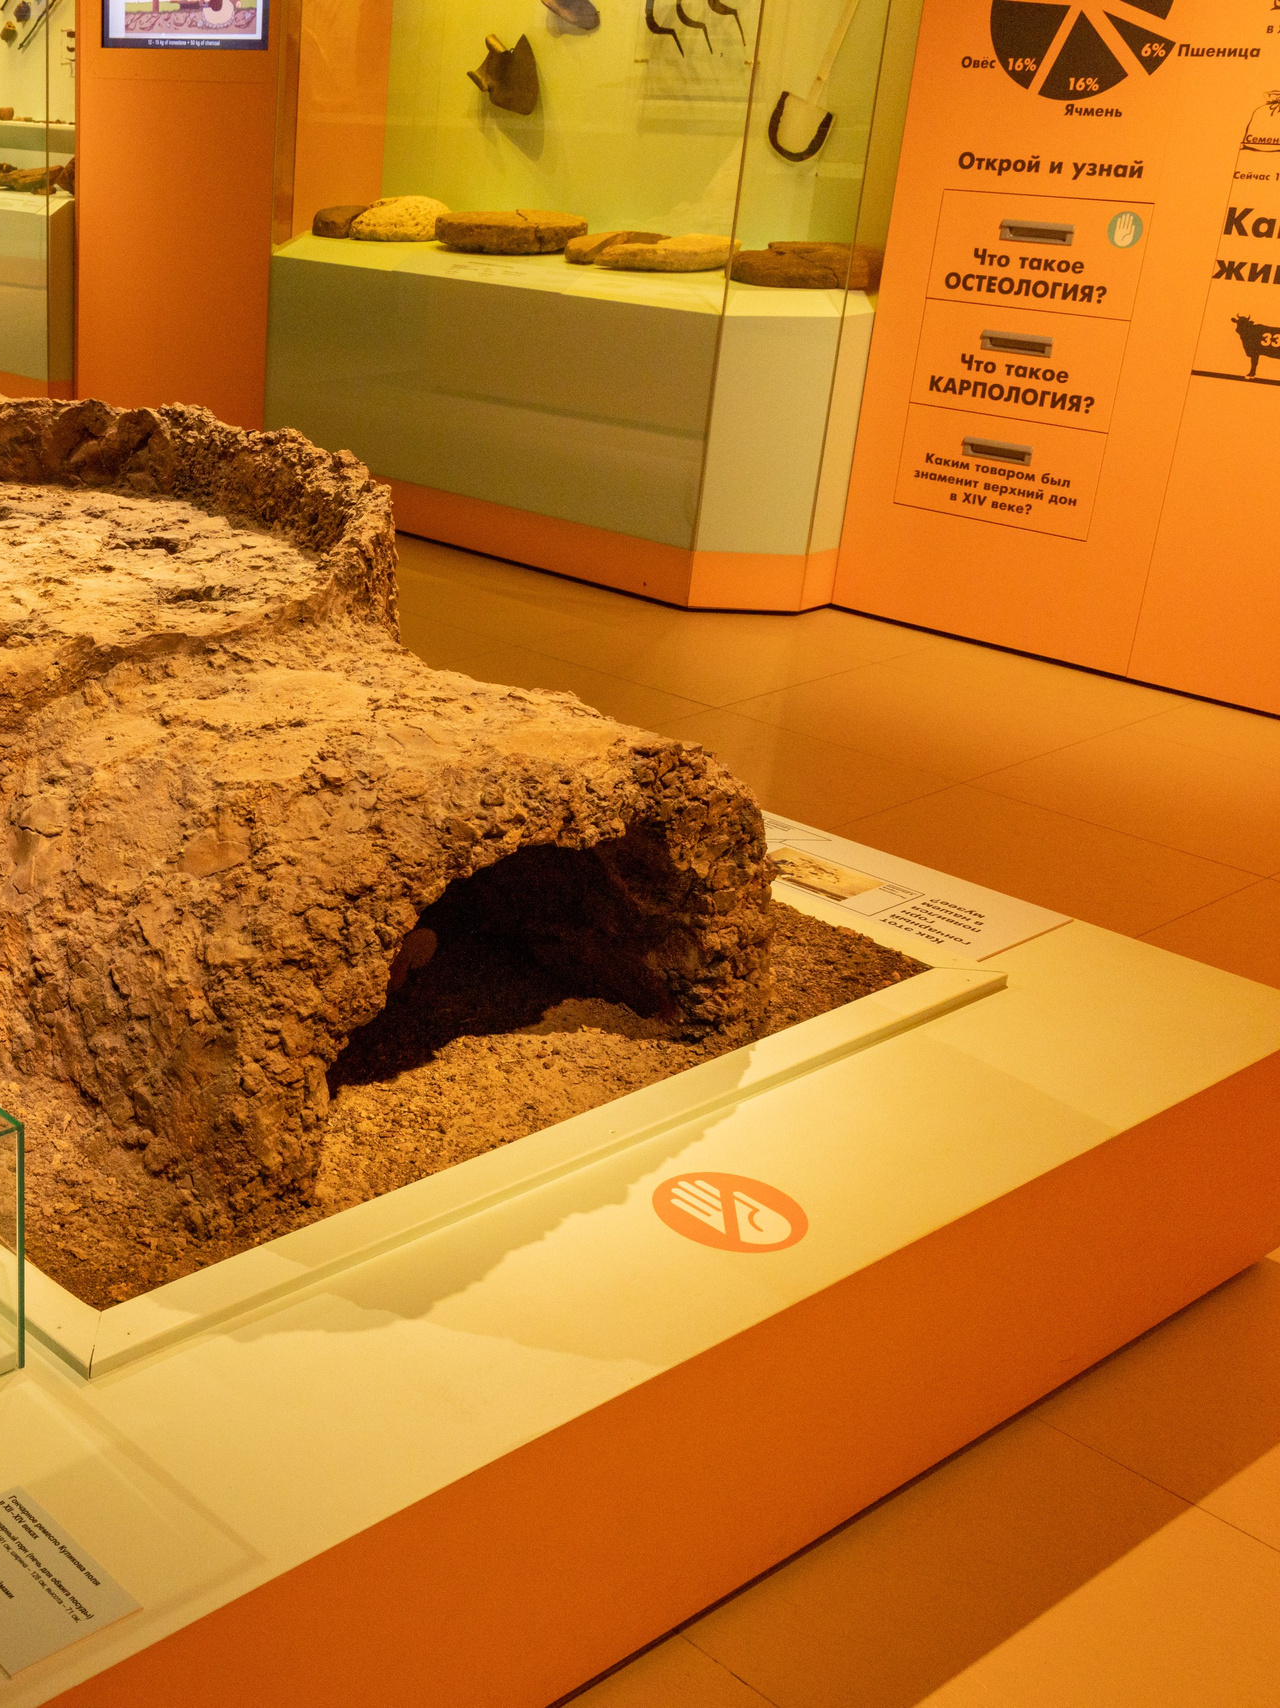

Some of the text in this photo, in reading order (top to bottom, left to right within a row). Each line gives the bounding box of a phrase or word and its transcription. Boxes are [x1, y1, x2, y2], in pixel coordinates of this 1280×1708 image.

[960, 56, 997, 70] Овёс
[1141, 43, 1166, 58] 6%
[1177, 43, 1261, 60] Пшеница
[1006, 58, 1037, 72] 16%
[1067, 77, 1100, 92] 16%
[1063, 103, 1123, 119] Ячмень
[1246, 134, 1279, 145] Семен
[958, 151, 1144, 180] Открой и узнай
[1233, 171, 1270, 181] Сейчас
[1223, 207, 1280, 239] Ка
[973, 248, 1085, 275] Что такое
[944, 271, 1107, 304] ОСТЕОЛОГИЯ?
[960, 353, 1070, 384] Что такое
[928, 375, 1095, 414] КАРПОЛОГИЯ?
[925, 452, 1071, 488] Каким товаром был
[913, 468, 1078, 507] знаменит верхний дон
[949, 492, 1033, 515] в XIV веке?
[900, 909, 936, 924] горн
[911, 905, 982, 933] появился
[921, 901, 972, 922] нашем
[929, 898, 985, 918] музее?
[878, 918, 945, 945] Как этот
[889, 913, 971, 945] гончарный
[8, 1495, 101, 1587] Гончарное ремесло Куликова поля
[21, 1523, 39, 1540] веках
[15, 1540, 29, 1554] горн
[25, 1552, 42, 1568] (печь
[39, 1567, 53, 1579] для
[50, 1577, 71, 1597] обжига
[69, 1596, 94, 1620] посуды)
